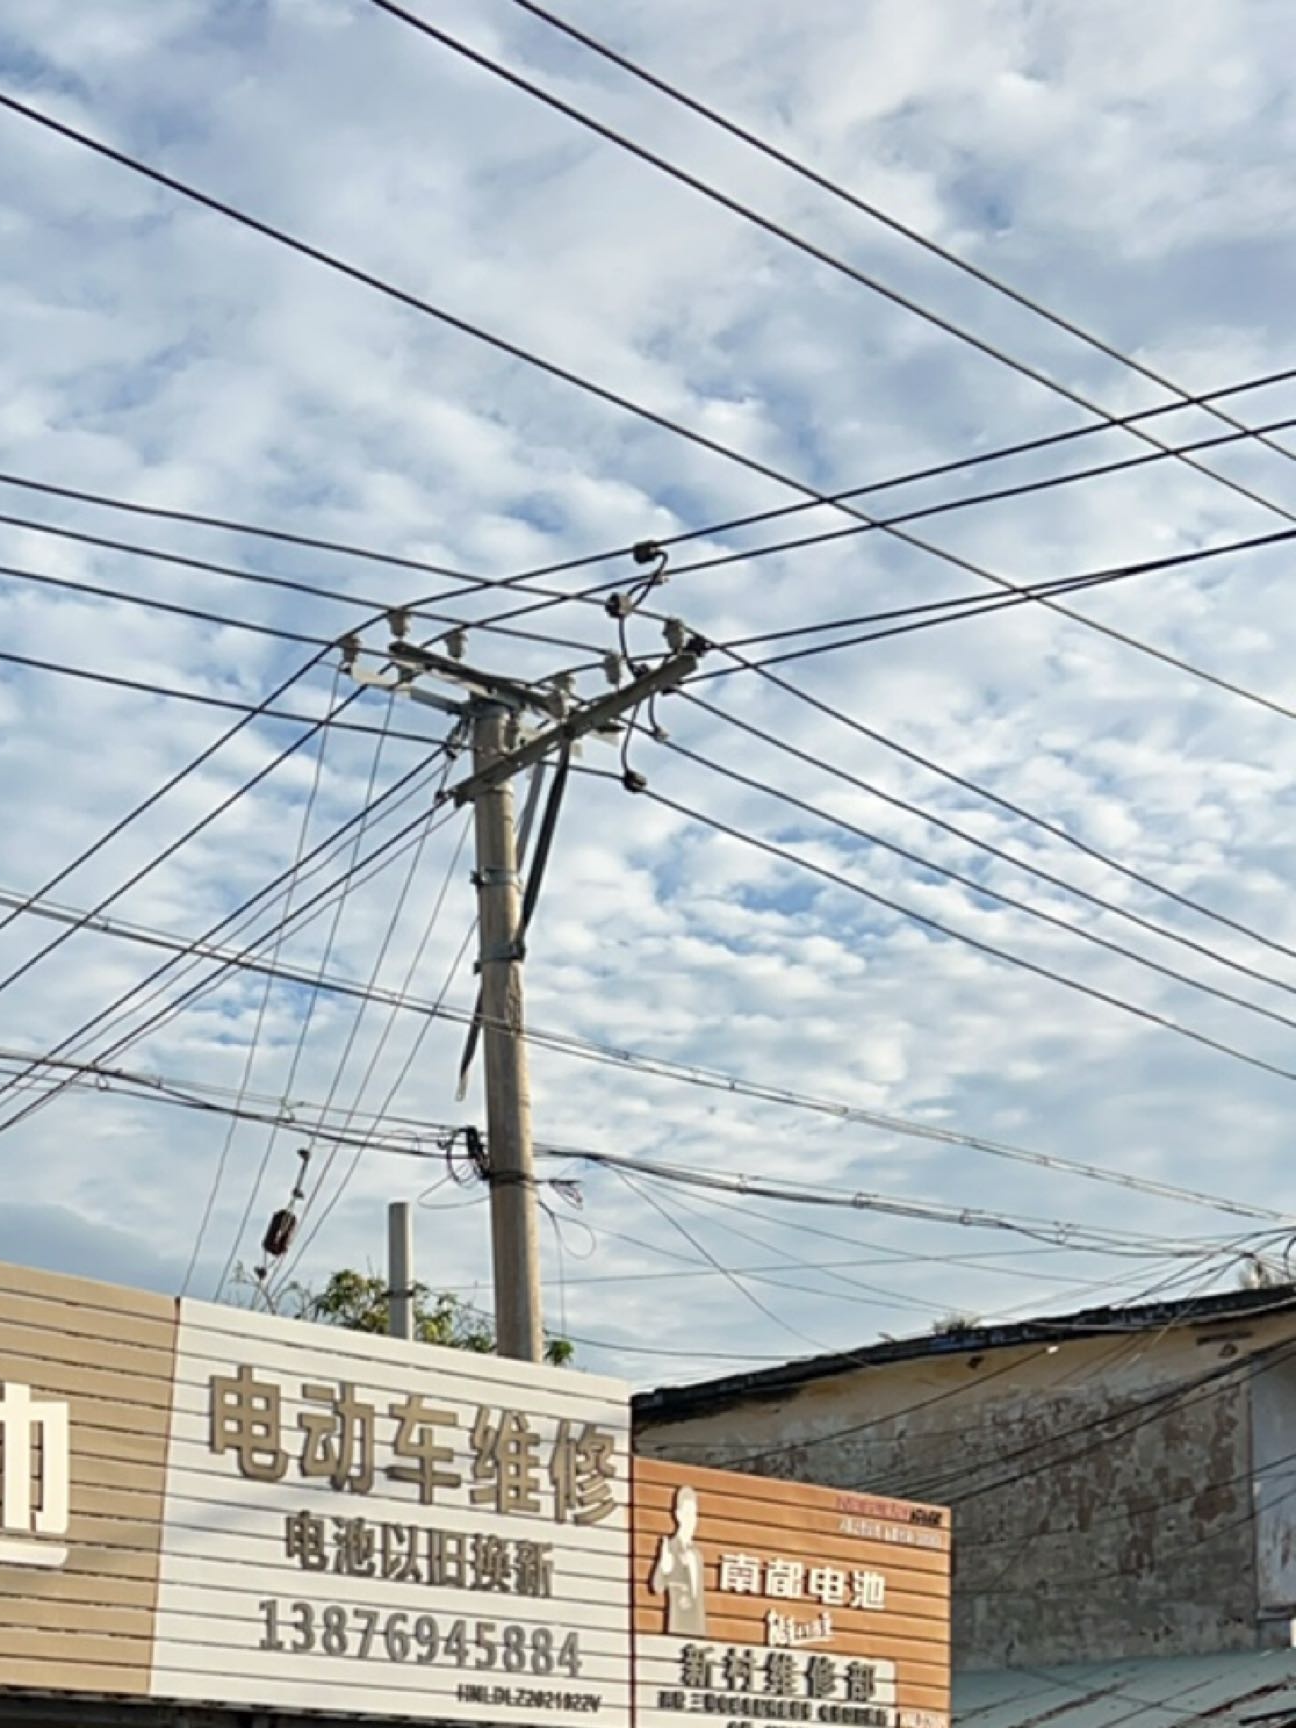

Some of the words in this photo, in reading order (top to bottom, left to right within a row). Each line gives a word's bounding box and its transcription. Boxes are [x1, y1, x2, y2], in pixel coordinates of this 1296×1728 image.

[208, 1365, 617, 1526] 电动车维修
[285, 1510, 555, 1598] 电池以旧换新
[719, 1553, 887, 1609] 南都电池
[258, 1598, 582, 1679] 13876945884
